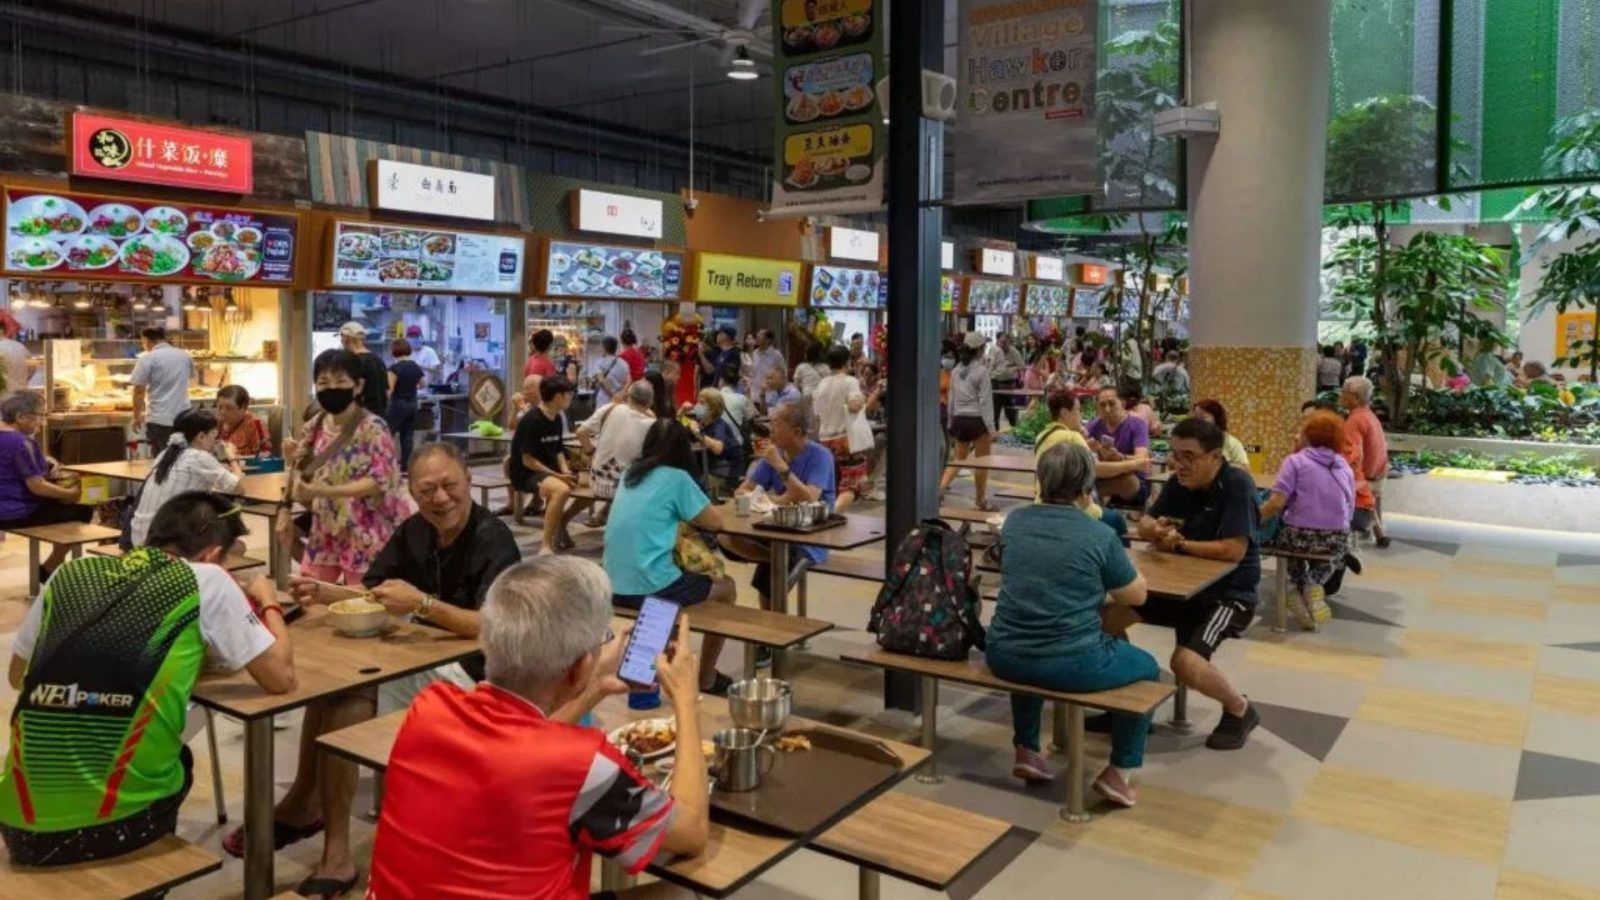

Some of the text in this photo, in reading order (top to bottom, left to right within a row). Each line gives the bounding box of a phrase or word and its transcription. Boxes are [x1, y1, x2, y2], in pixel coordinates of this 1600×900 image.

[969, 14, 1085, 49] Village
[967, 48, 1083, 84] Hawker
[967, 81, 1083, 114] Centre
[707, 269, 773, 290] Tray Return
